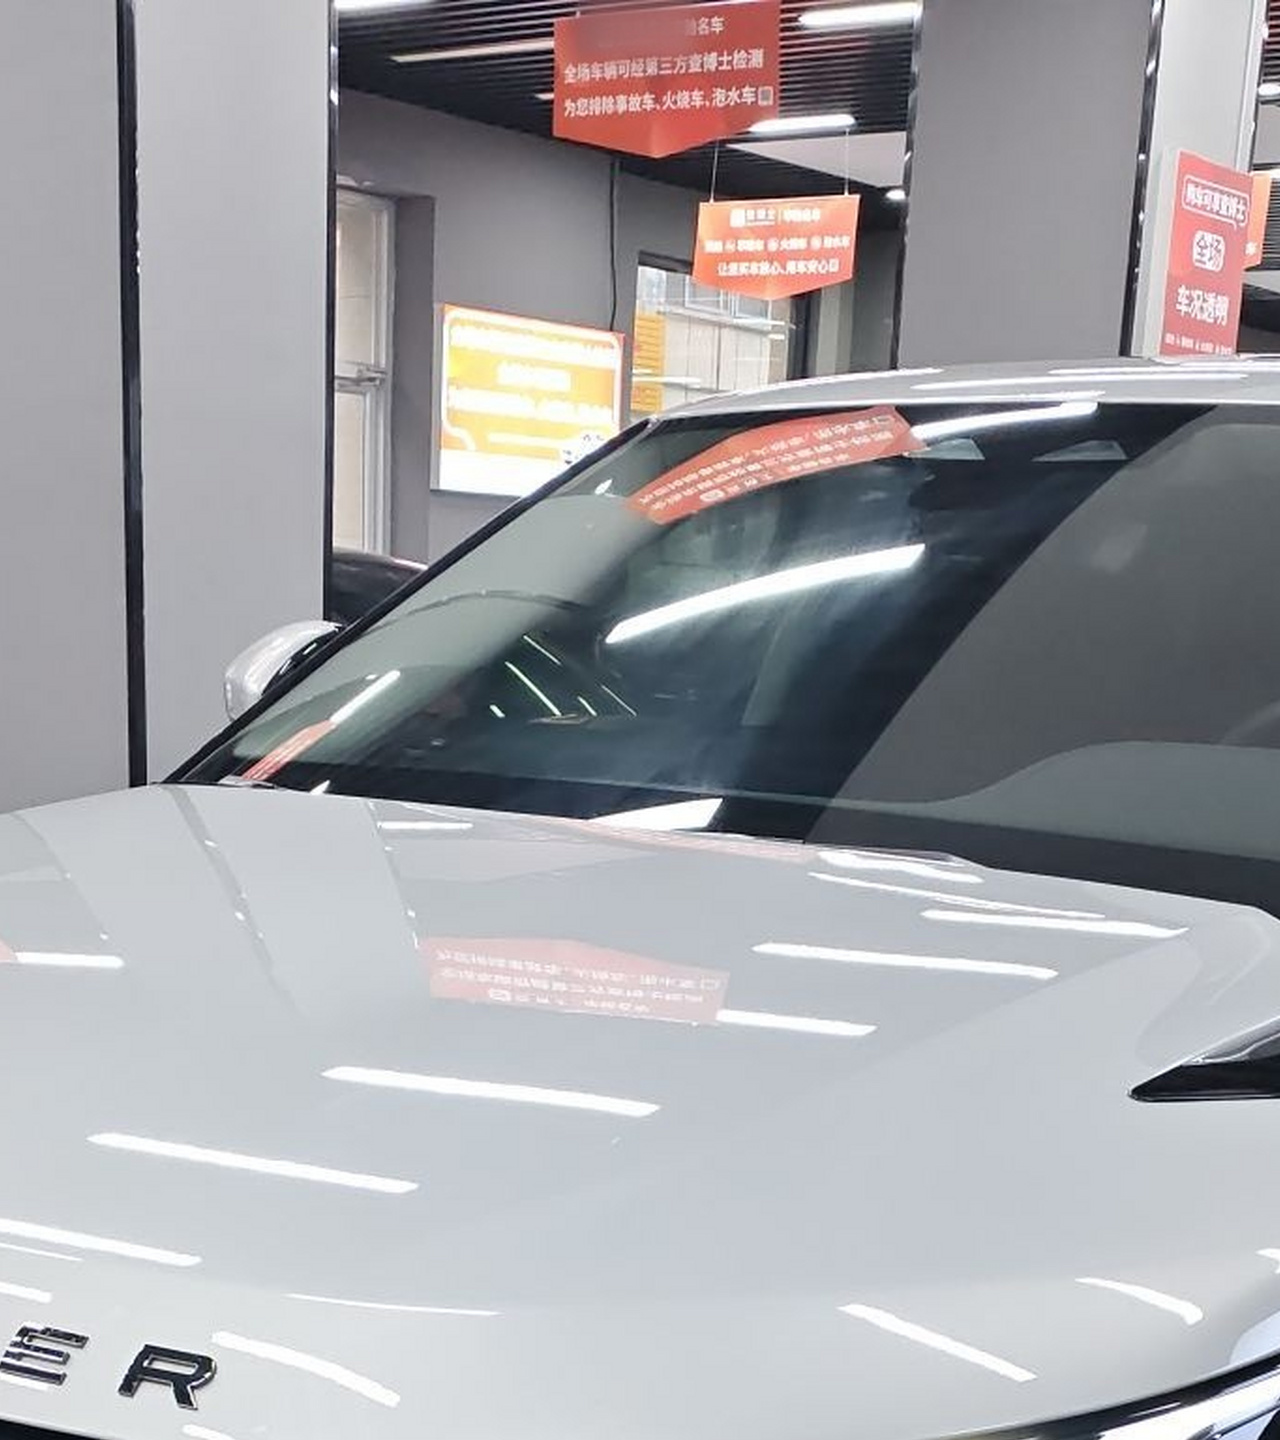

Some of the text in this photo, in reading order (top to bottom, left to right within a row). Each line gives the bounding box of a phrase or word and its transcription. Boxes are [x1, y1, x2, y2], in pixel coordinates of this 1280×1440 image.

[564, 48, 764, 84] 全场车辆可经第三方查博士检测
[1176, 285, 1229, 326] 车况透明
